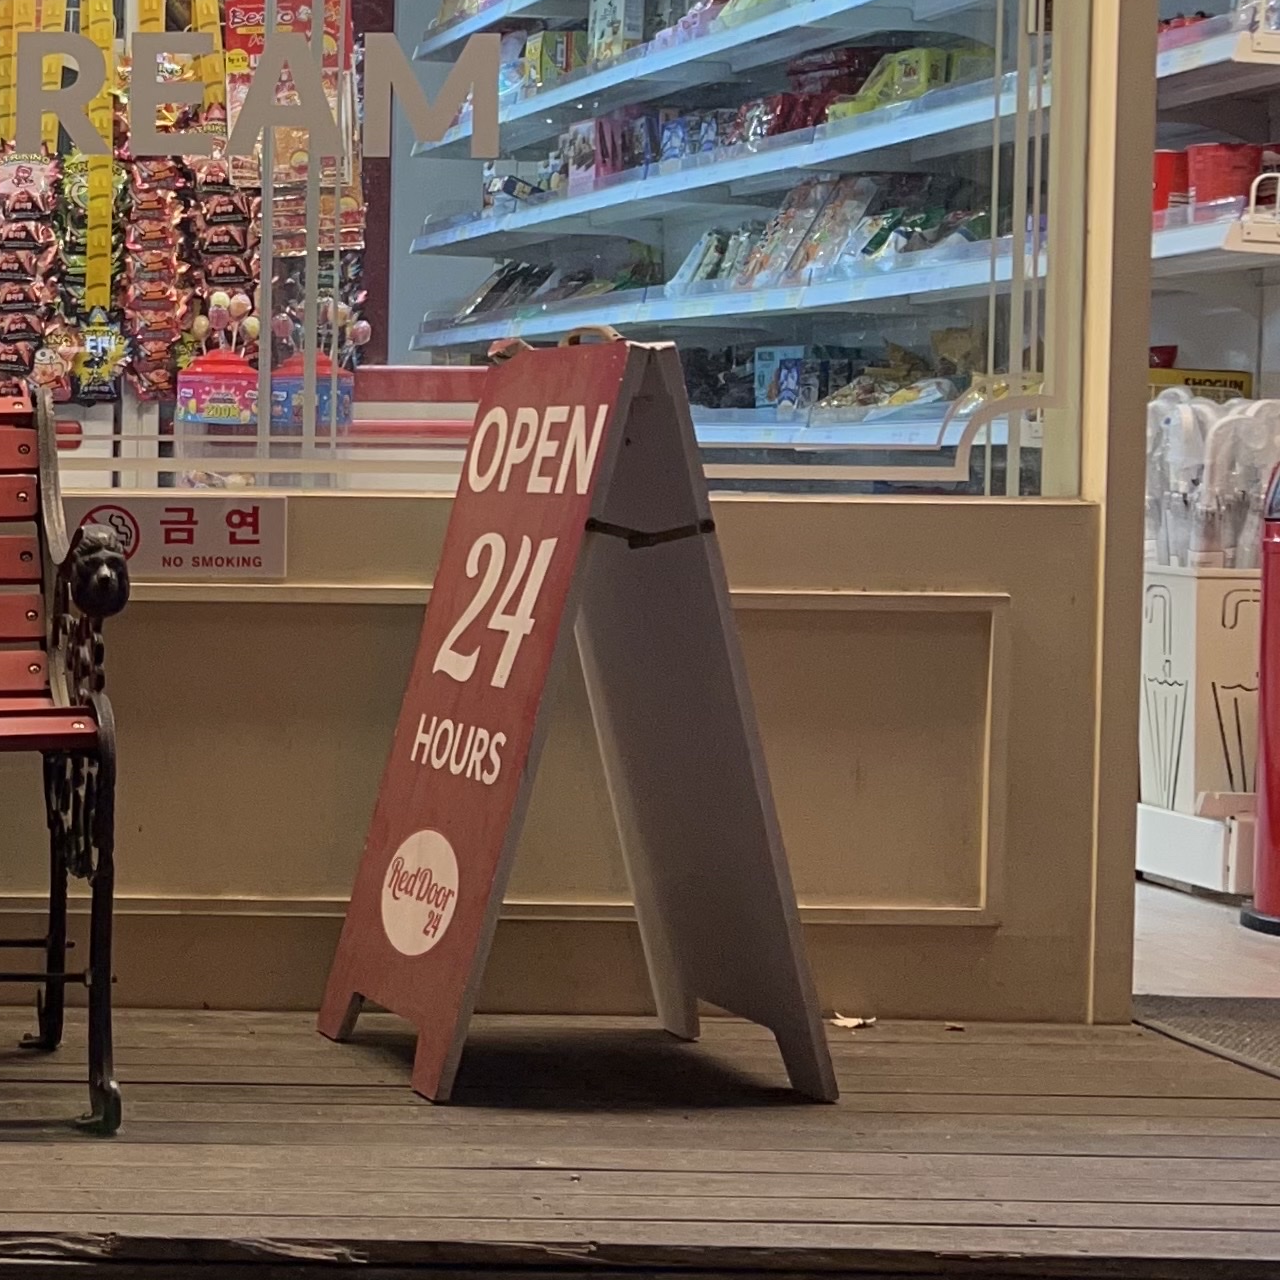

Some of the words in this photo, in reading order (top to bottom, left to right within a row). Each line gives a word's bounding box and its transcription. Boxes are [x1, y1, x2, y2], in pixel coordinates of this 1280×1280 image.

[467, 404, 610, 496] OPEN
[162, 556, 184, 568] NO
[191, 556, 263, 568] SMOKING
[431, 532, 559, 689] 24
[411, 713, 507, 785] HOURS
[388, 856, 455, 911] RedDoor
[422, 909, 442, 938] 24
